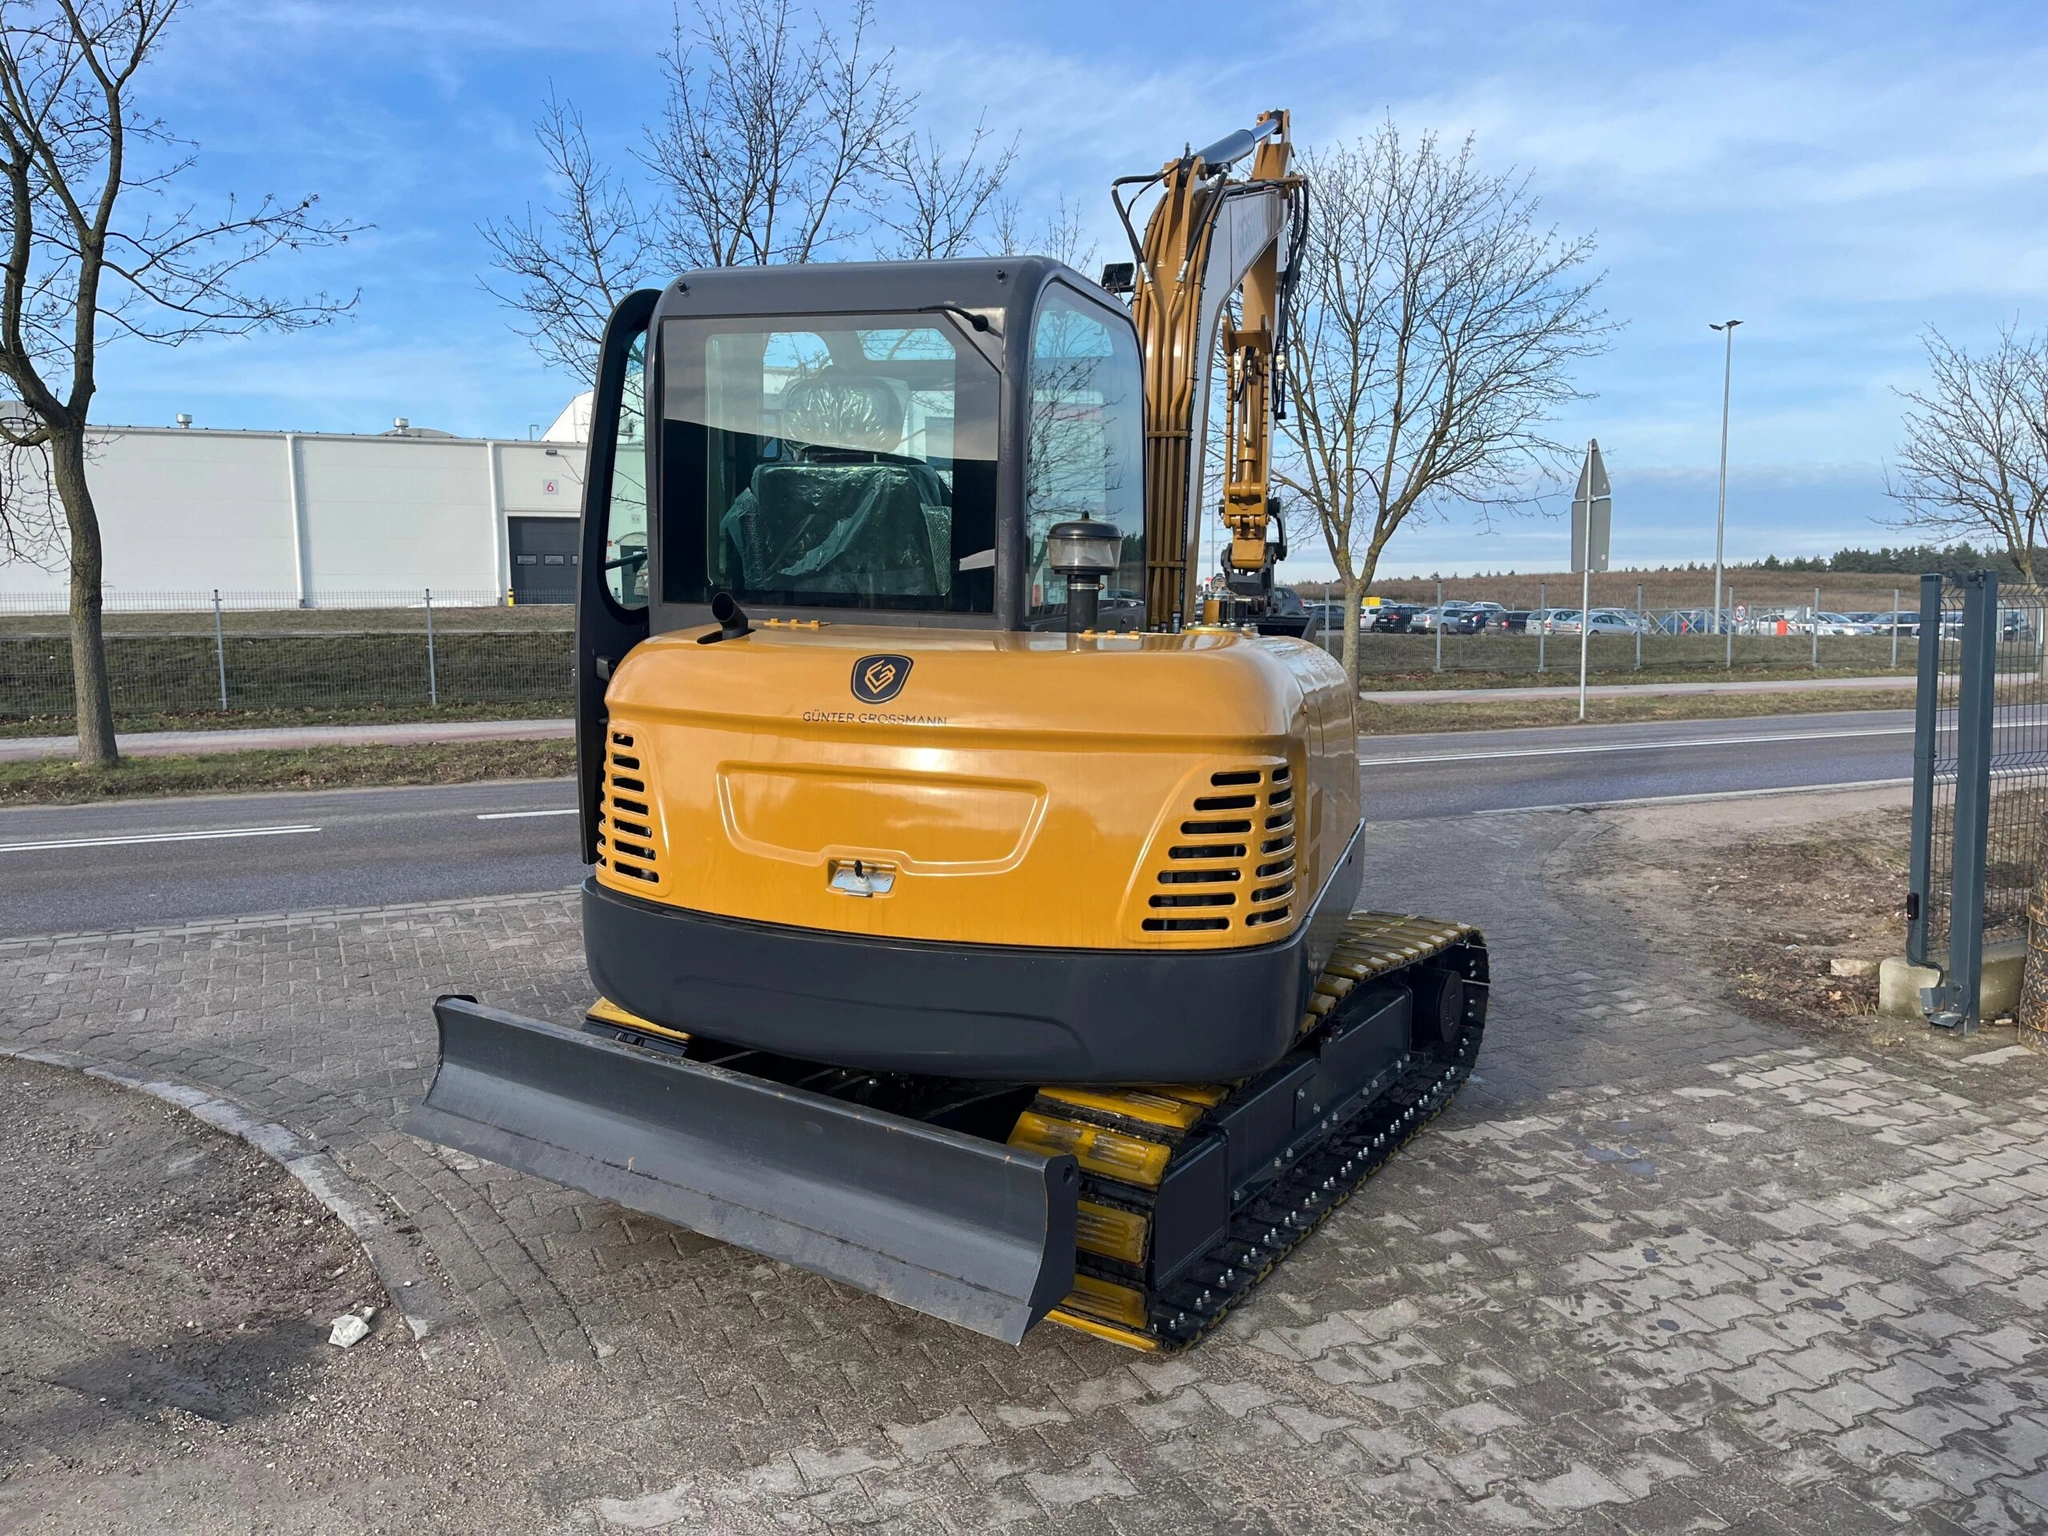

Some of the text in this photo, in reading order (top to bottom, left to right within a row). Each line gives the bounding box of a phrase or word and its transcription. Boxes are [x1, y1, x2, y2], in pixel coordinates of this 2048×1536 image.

[546, 481, 554, 493] 6
[802, 709, 947, 725] GÜNTER GROSSMANN
